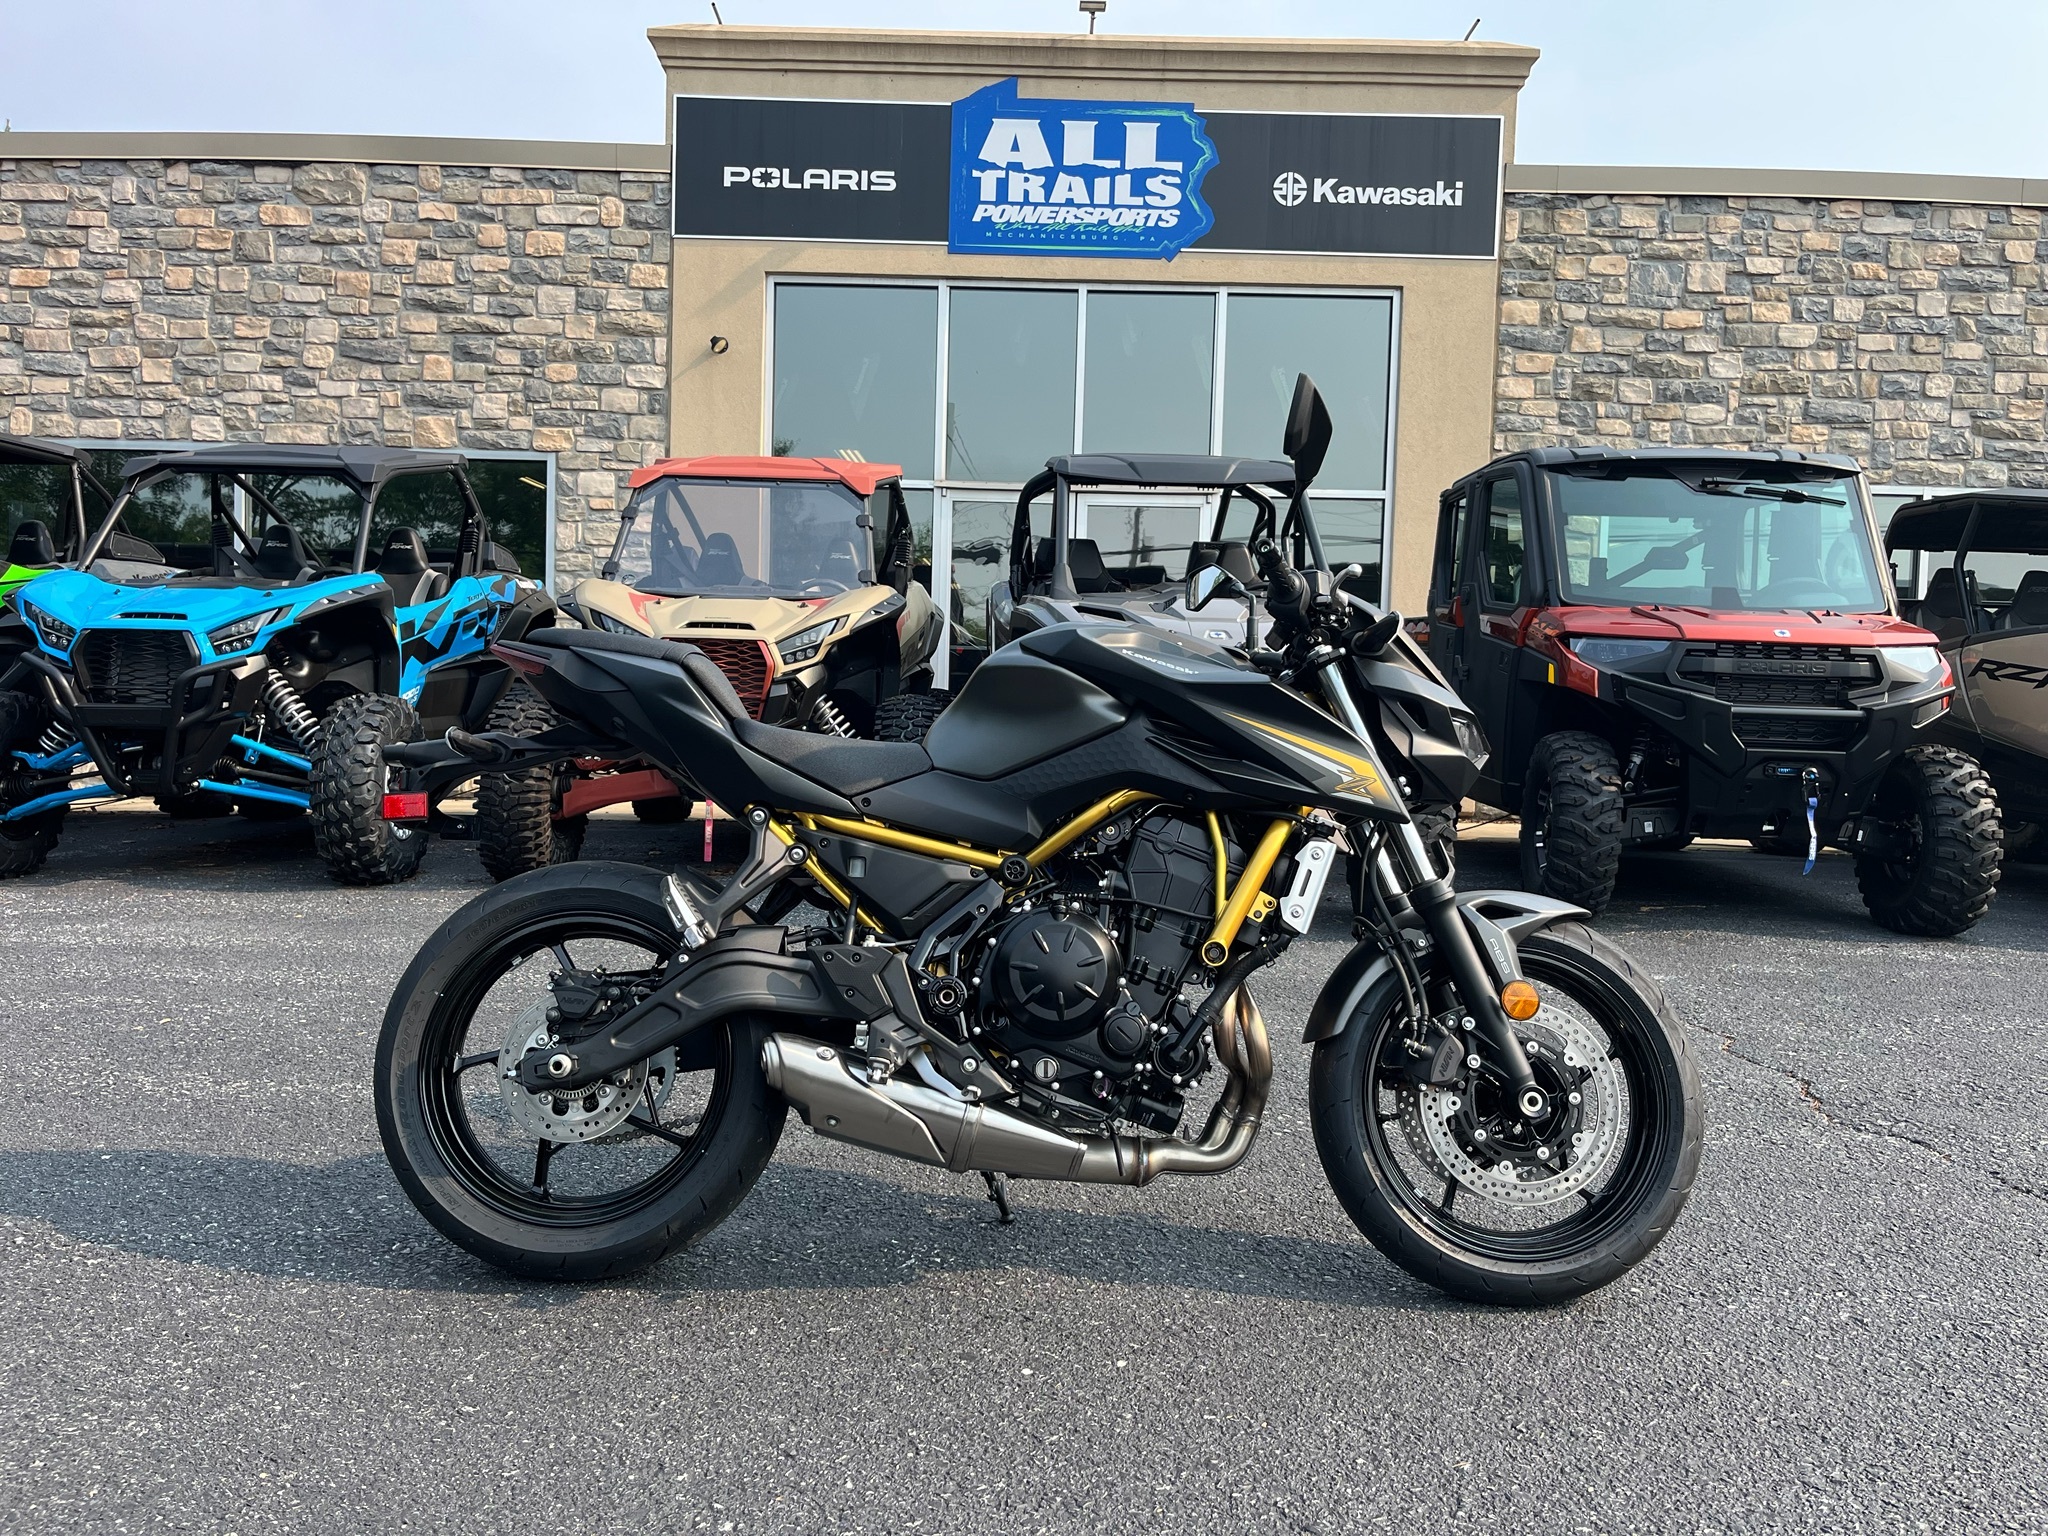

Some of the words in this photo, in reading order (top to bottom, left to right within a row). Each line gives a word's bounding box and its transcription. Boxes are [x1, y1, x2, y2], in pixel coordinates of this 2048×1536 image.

[977, 118, 1183, 173] ALL
[723, 166, 897, 192] POLARIS
[972, 169, 1182, 207] TRAILS
[1313, 177, 1464, 206] Kawasaki
[972, 204, 1181, 229] POWERSPORTS
[1122, 648, 1199, 675] Kawasaki
[1736, 661, 1827, 676] POLARIS
[1967, 657, 2048, 690] RZ
[1489, 937, 1511, 974] ABS
